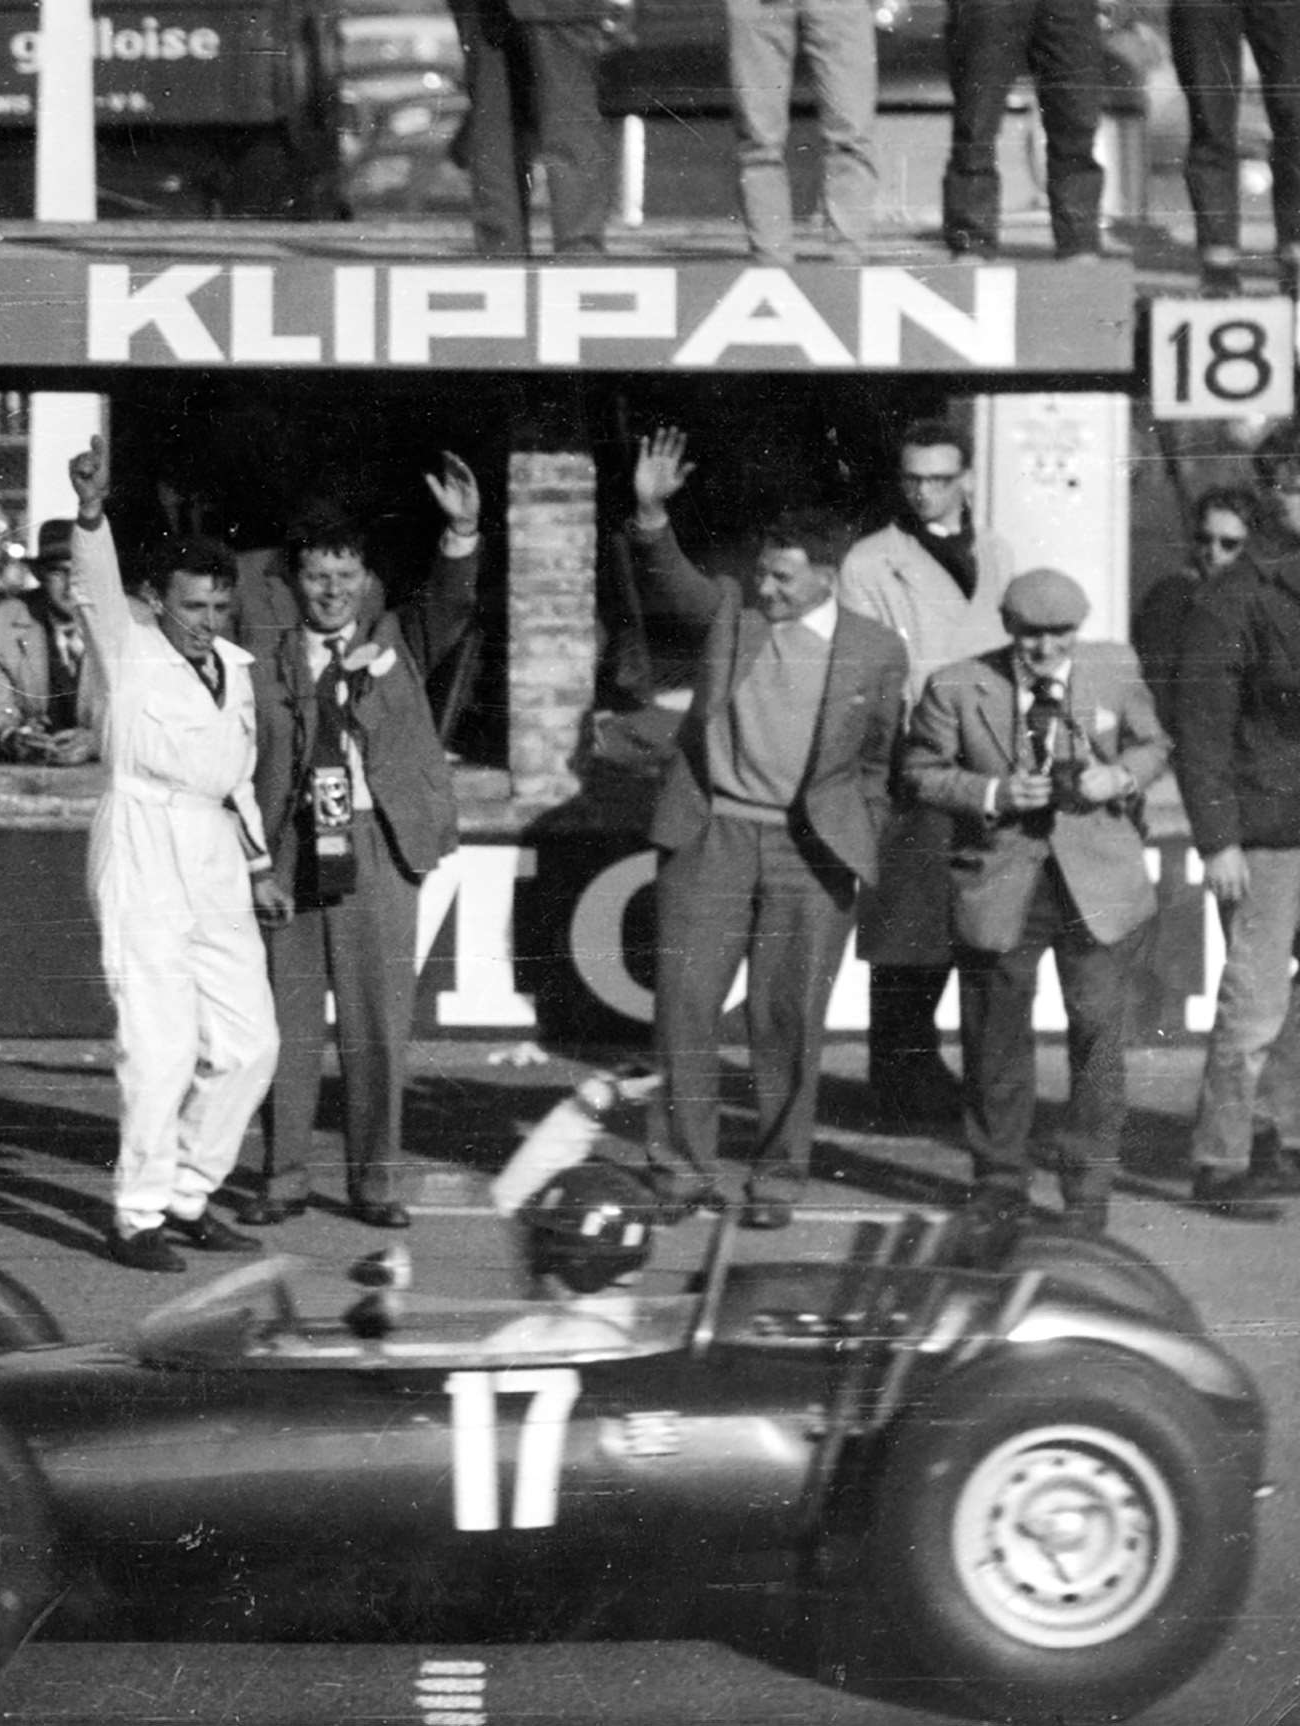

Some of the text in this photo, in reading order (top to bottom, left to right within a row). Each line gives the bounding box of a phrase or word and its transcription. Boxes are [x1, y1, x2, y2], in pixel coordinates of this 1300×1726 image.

[88, 263, 1017, 367] KLIPPAN
[1169, 320, 1273, 403] 18
[445, 1367, 581, 1531] 17
